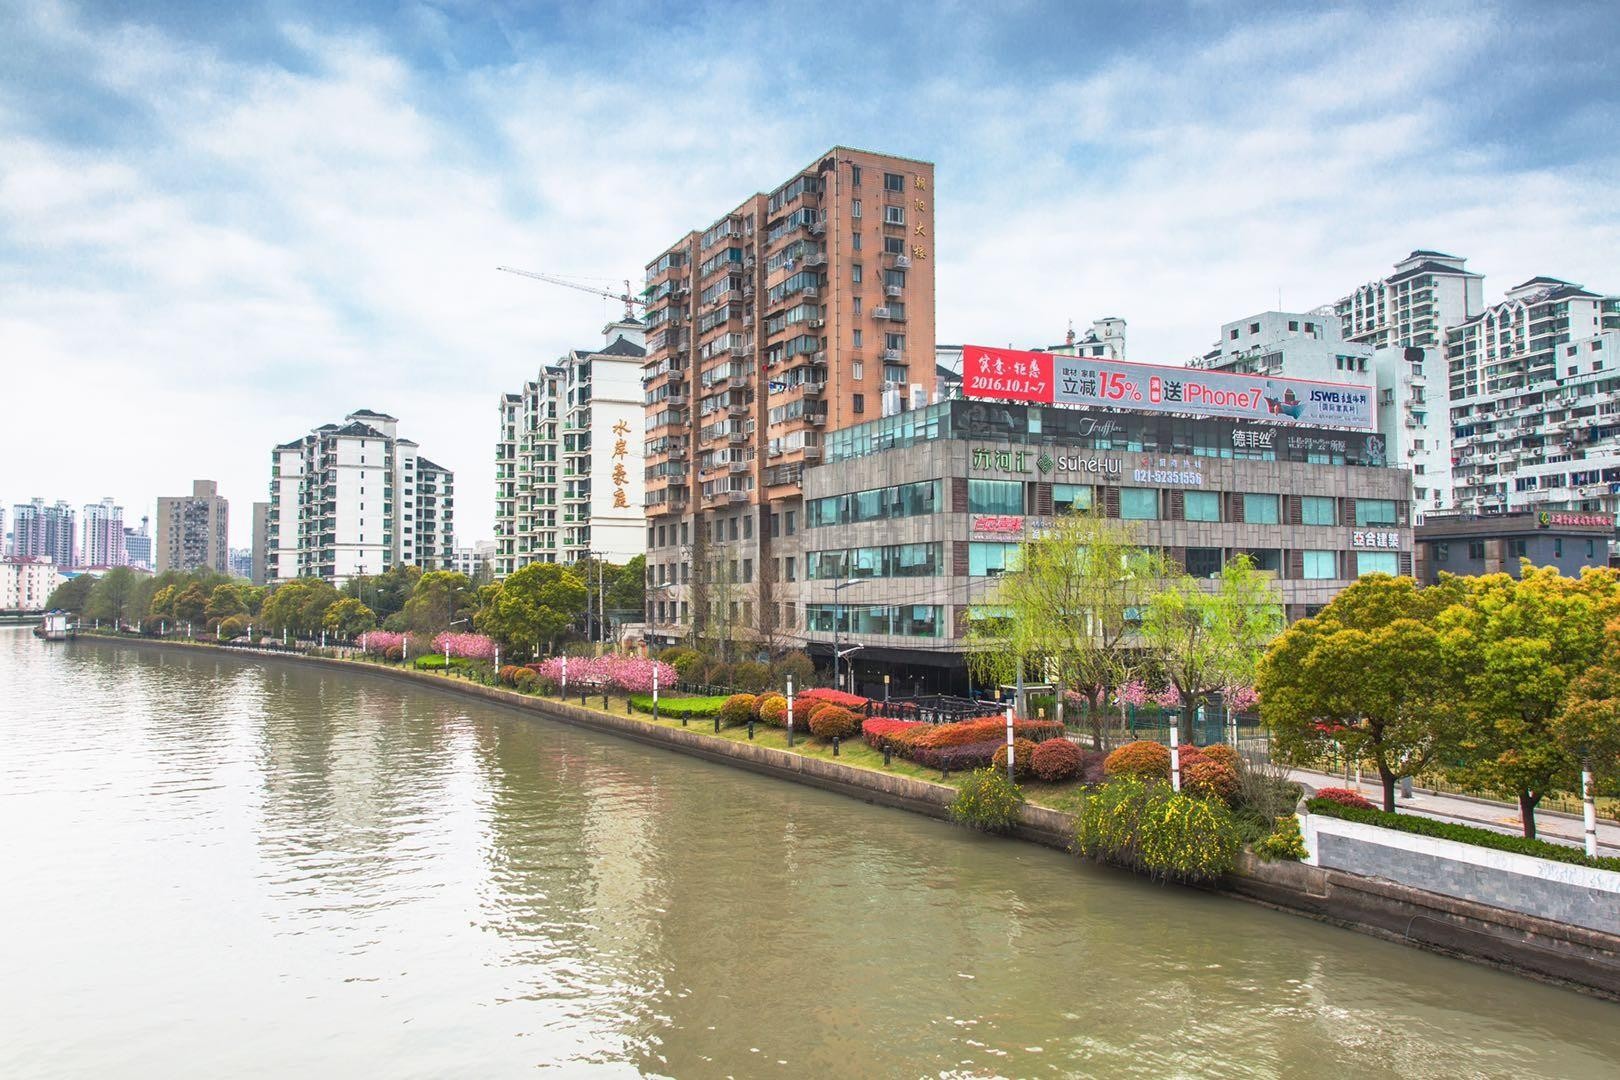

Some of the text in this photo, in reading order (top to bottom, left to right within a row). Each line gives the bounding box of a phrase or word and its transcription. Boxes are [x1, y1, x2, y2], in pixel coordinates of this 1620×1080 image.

[971, 375, 1046, 395] 2016.10.1~7
[1062, 377, 1097, 397] 立减
[1099, 371, 1142, 401] 15%
[1310, 390, 1340, 403] JSWB
[1232, 429, 1274, 449] 德菲丝
[972, 448, 1034, 474] 苏河汇
